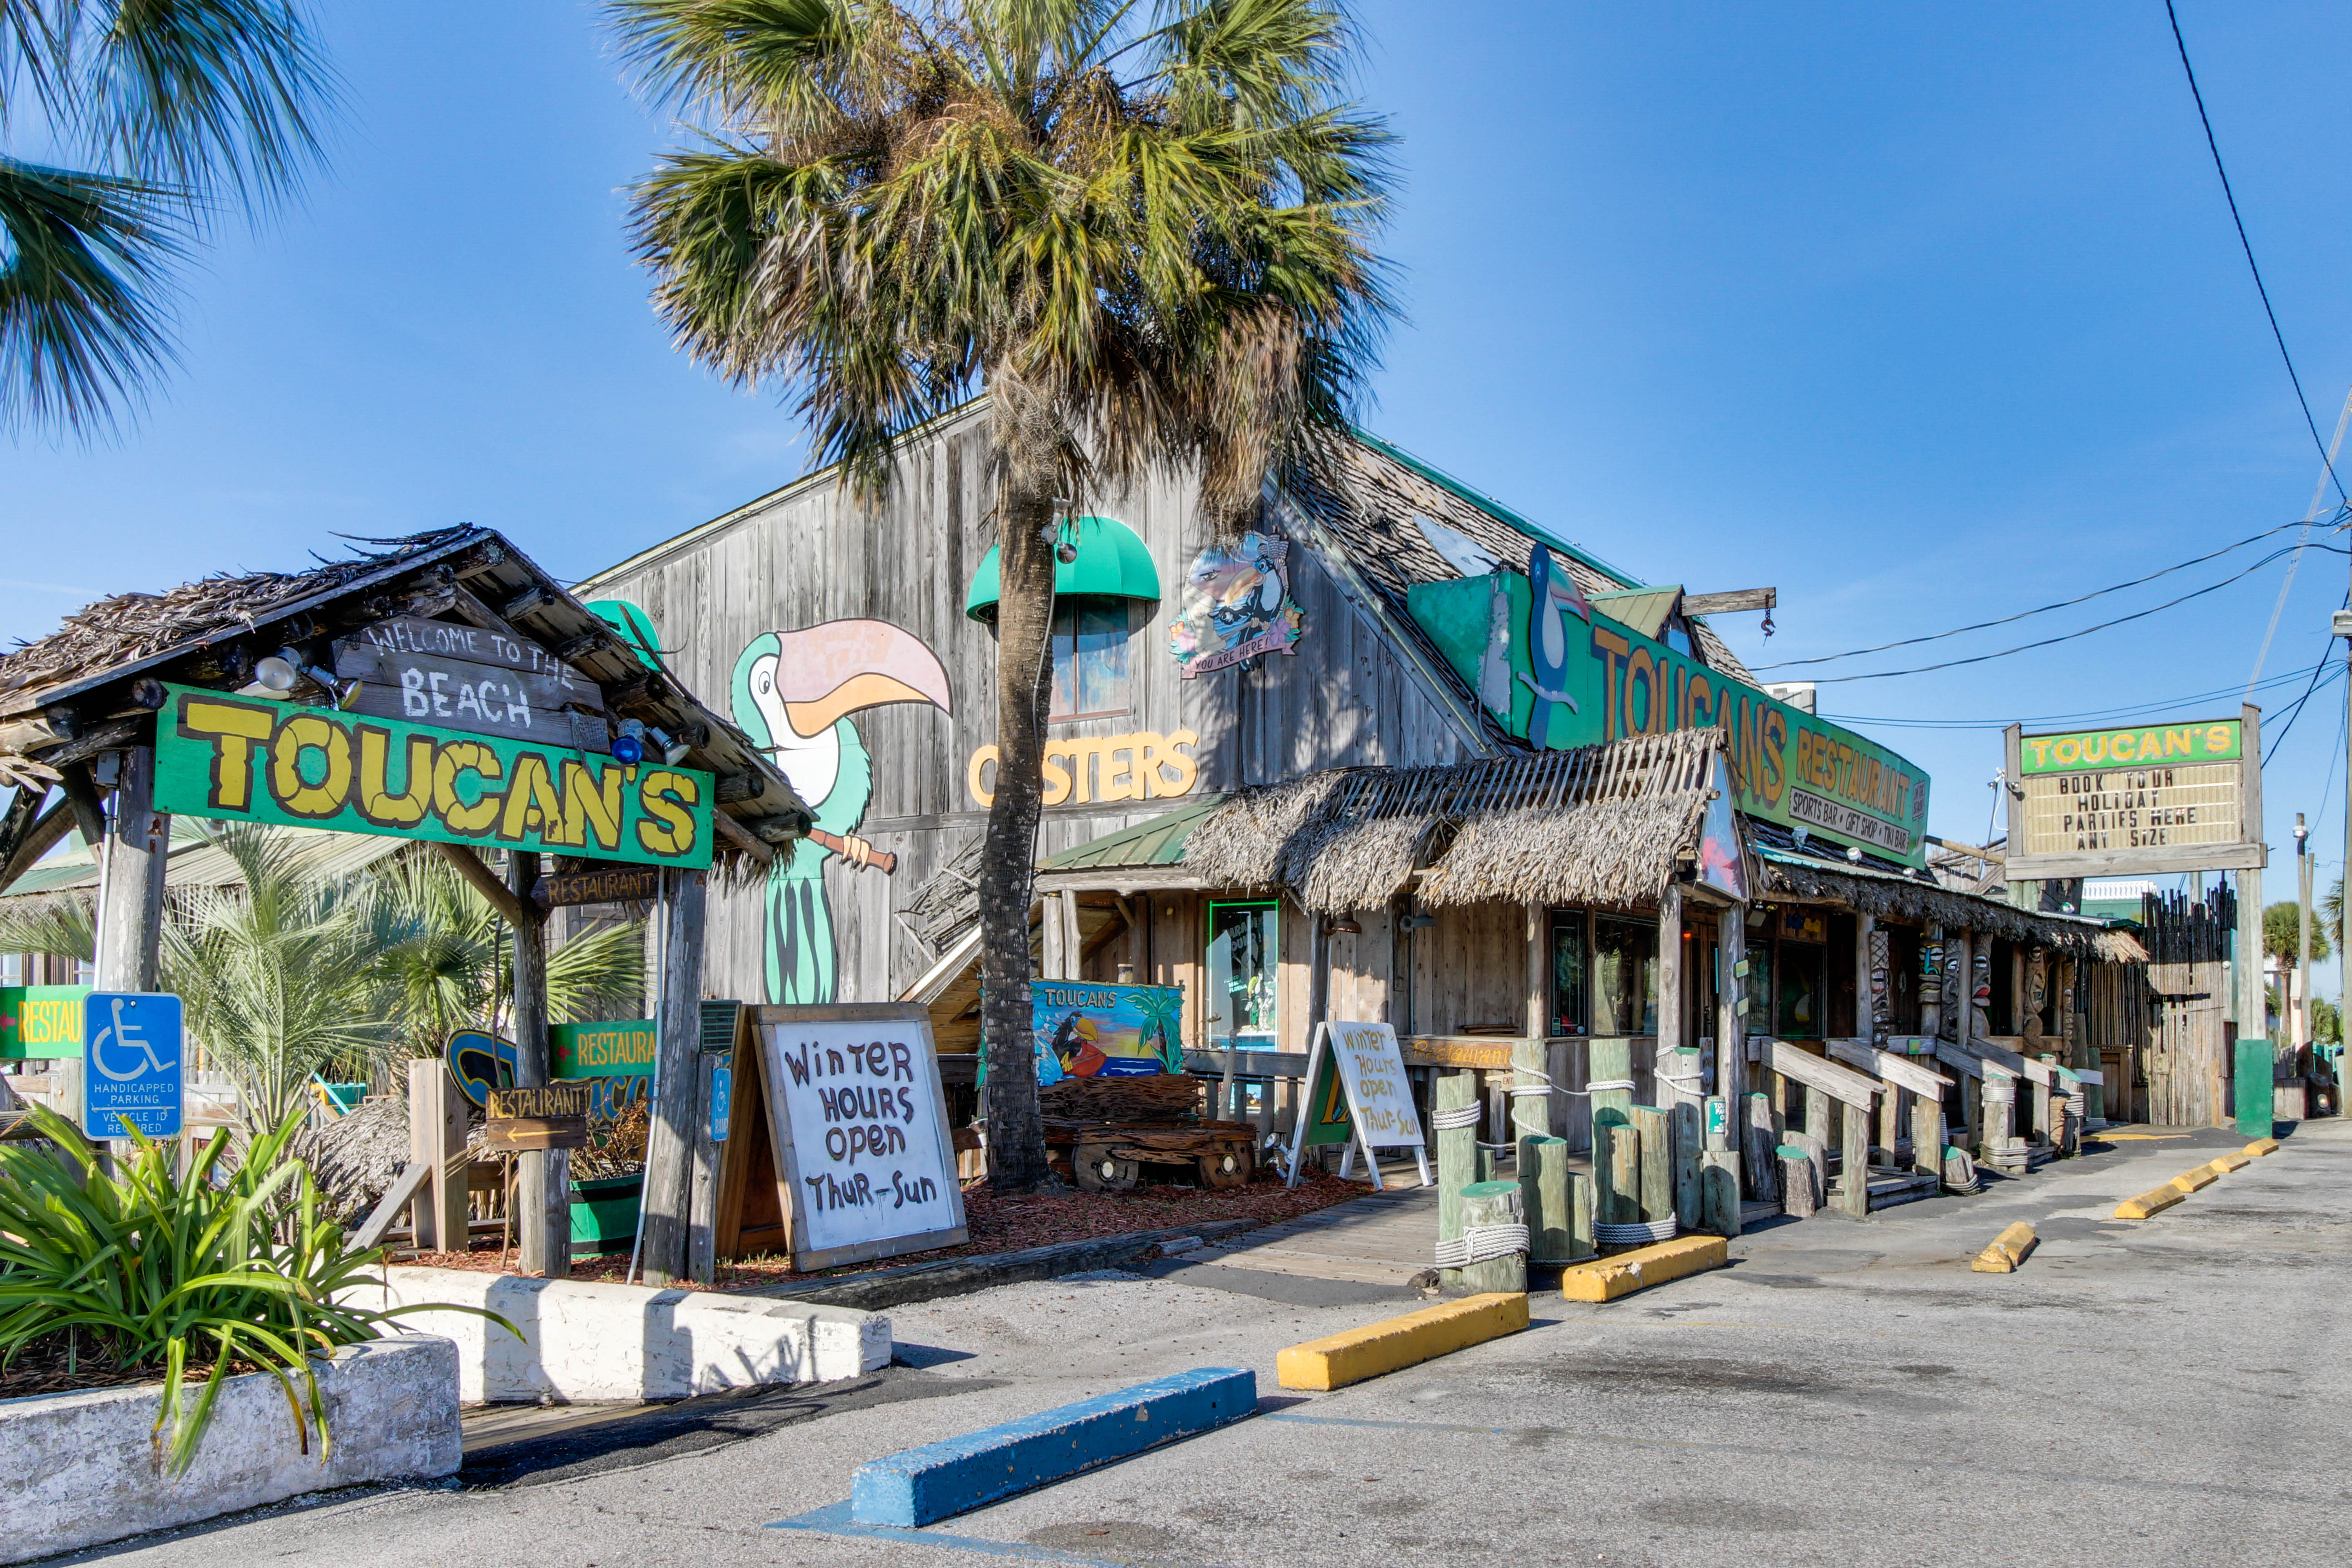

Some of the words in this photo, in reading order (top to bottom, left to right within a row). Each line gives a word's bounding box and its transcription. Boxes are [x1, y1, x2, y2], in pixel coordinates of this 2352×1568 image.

[368, 622, 478, 657] WELCOME
[490, 636, 521, 662] TO
[527, 646, 574, 691] THE
[1195, 659, 1213, 670] YOU
[1218, 652, 1235, 666] ARE
[1240, 636, 1269, 658] HERE!
[400, 667, 532, 728] BEACH
[2029, 725, 2232, 768] TOUCAN'S
[177, 692, 700, 858] TOUCAN'S
[968, 730, 1199, 809] OSTERS
[1796, 727, 1910, 820] RESTAURANT
[2060, 774, 2104, 794] BOOK
[2125, 769, 2173, 789] YOUR
[1793, 792, 1822, 821] SPORTS
[1823, 804, 1838, 826] BAR
[1846, 812, 1860, 834] GIFT
[1862, 817, 1878, 842] SHOP
[1884, 825, 1894, 846] TIKI
[1895, 830, 1906, 849] BAR
[2150, 807, 2196, 826] HERE
[2078, 832, 2108, 851] ANY
[547, 872, 654, 904] RESTAURANT
[1045, 988, 1118, 1008] TOUCANS
[18, 1000, 82, 1043] RESTAU
[578, 1030, 657, 1066] RESTAURA
[1412, 1039, 1513, 1065] Restaurant
[94, 1083, 174, 1093] HANDICAPPED
[111, 1095, 159, 1104] PARKING
[489, 1087, 583, 1119] RESTAURANT
[103, 1112, 149, 1122] VECLE
[157, 1112, 167, 1121] ID
[715, 1117, 729, 1134] RAMP
